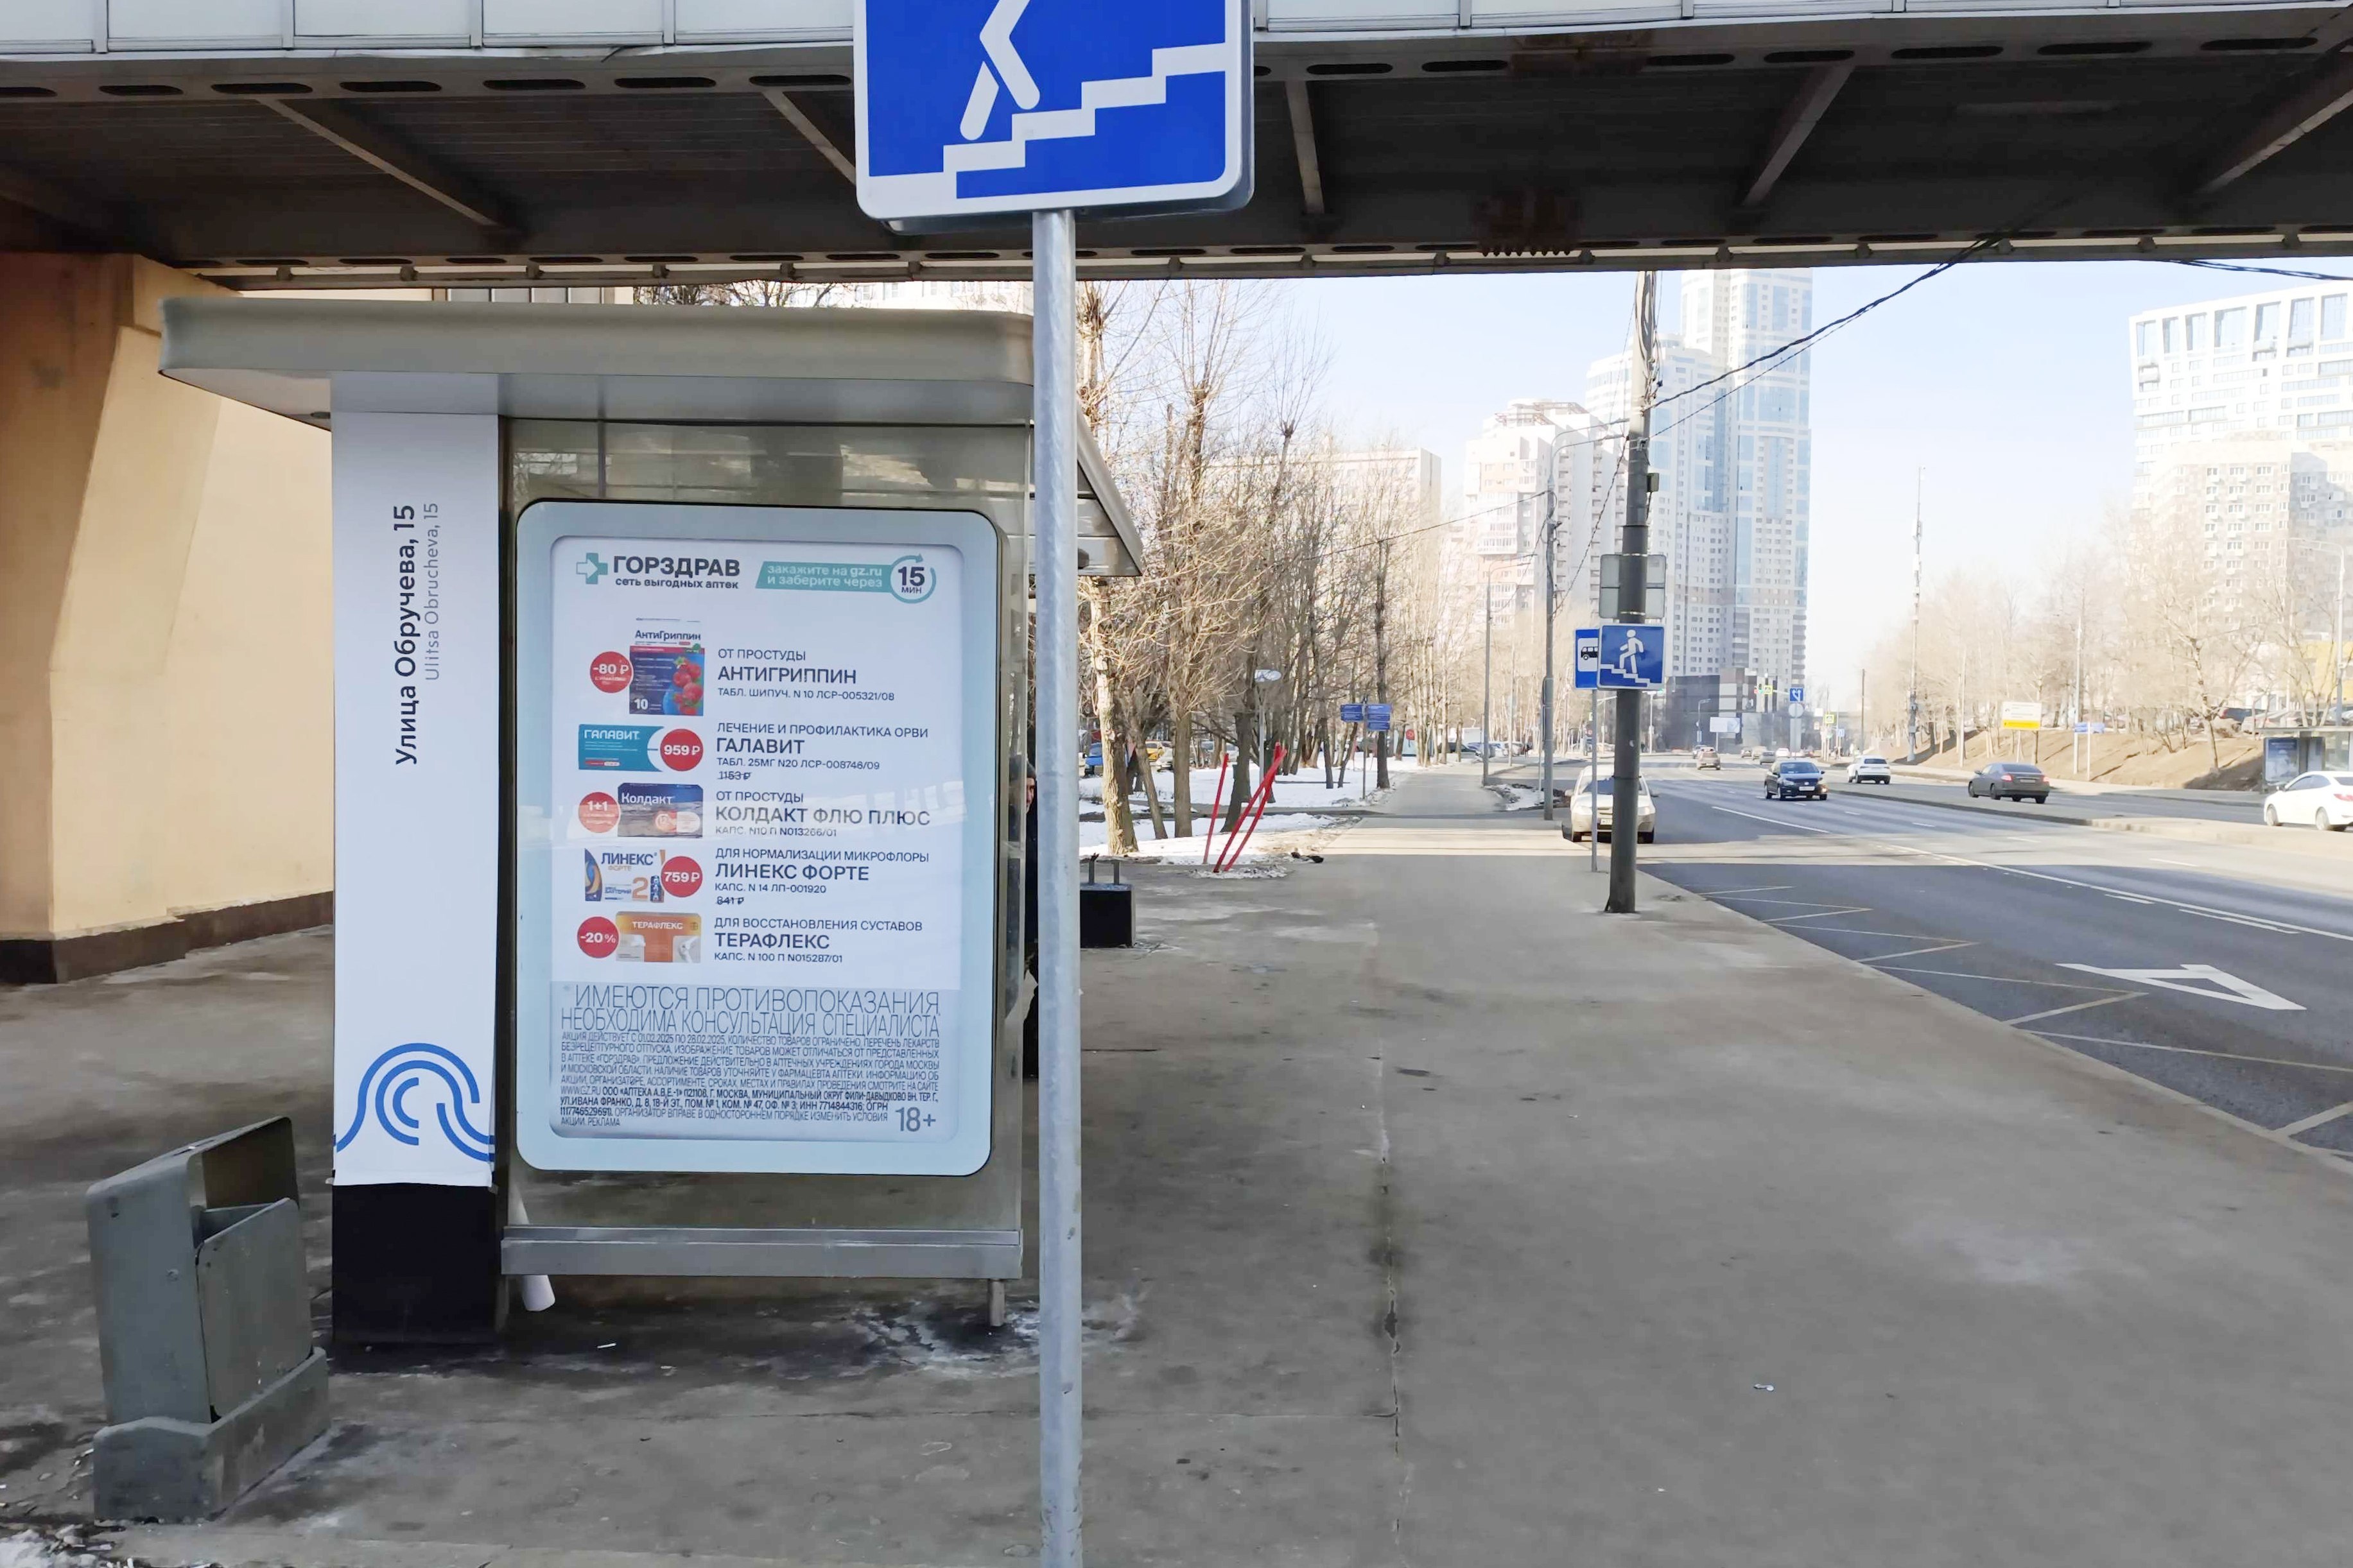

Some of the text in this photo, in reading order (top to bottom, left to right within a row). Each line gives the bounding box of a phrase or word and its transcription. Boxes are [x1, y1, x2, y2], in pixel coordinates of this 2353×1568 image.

[614, 556, 740, 578] ГОРЗДРАВ
[767, 565, 882, 578] закажите на gz.ru
[615, 578, 738, 589] сеть выгодных аптек
[767, 575, 882, 589] и заберите через
[898, 566, 926, 587] 15
[424, 503, 440, 681] Ulitsa Obrucheva, 15
[394, 505, 420, 764] Улица Обручева, 15
[635, 630, 701, 641] АнтиГриппин
[718, 648, 806, 662] ОТ ПРОСТУДЫ
[593, 664, 617, 675] -80
[718, 666, 856, 684] АНТИГРИППИН
[718, 688, 894, 701] ТАБЛ. ШИПУЧ. N 10 ЛСР-005321/08
[634, 698, 648, 710] 10
[717, 723, 928, 737] ЛЕЧЕНИЕ И ПРОФИЛАКТИКА ОРВИ
[664, 745, 690, 755] 959
[716, 737, 805, 754] ГАЛАВИТ
[717, 757, 746, 766] ТАБЛ.
[748, 758, 776, 767] 25МГ
[778, 759, 798, 768] N20
[621, 792, 674, 806] Колдакт
[716, 791, 803, 804] ОТ ПРОСТУДЫ
[587, 801, 608, 812] 1+1
[716, 806, 930, 826] КОЛДАКТ ФЛЮ ПЛЮС
[715, 826, 745, 835] КАПС.
[749, 827, 767, 836] N10
[770, 827, 777, 836] П
[601, 853, 654, 865] ЛИНЕКС
[715, 848, 929, 863] ДЛЯ НОРМАЛИЗАЦИИ МИКРОФЛОРЫ
[664, 872, 690, 883] 759
[715, 863, 869, 881] ЛИНЕКС ФОРТЕ
[715, 883, 826, 893] КАПС. N 14 ЛП-001920
[632, 922, 684, 930] ТЕРАФЛЕКС
[714, 917, 923, 931] ДЛЯ ВОССТАНОВЛЕНИЯ СУСТАВОВ
[580, 933, 603, 943] -20
[715, 932, 829, 949] ТЕРАФЛЕКС
[714, 952, 745, 961] КАПС.
[748, 953, 755, 961] N
[758, 953, 775, 961] 100
[576, 985, 689, 1010] ИМЕЮТСЯ
[561, 1007, 940, 1037] НЕОБХОДИМА КОНСУЛЬТАЦИЯ СПЕЦИАЛИСТА
[562, 1031, 587, 1041] АКЦИЯ
[587, 1031, 630, 1042] ДЕЙСТВУЕТ
[675, 1034, 686, 1044] ПО
[728, 1035, 777, 1046] КОЛИЧЕСТВО
[778, 1036, 811, 1046] ТОВАРОВ
[864, 1038, 901, 1047] ПЕРЕЧЕНЬ
[903, 1038, 940, 1048] ЛЕКАРСТВ
[561, 1042, 939, 1058] БЕЗРЕЦЕПТУРНОГО ИЗОБРАЖЕНИЕ ТОВАРОВ МОЖЕТ ОТЛИЧАТЬСЯ ОТ ПРЕДСТАВЛЕННЫХ
[568, 1053, 595, 1063] АПТЕКЕ
[643, 1055, 699, 1065] ПРЕДЛОЖЕНИЕ
[700, 1056, 765, 1067] ДЕЙСТВИТЕЛЬНО
[773, 1058, 814, 1067] АПТЕЧНЫХ
[816, 1059, 873, 1069] УЧРЕЖДЕНИЯХ
[874, 1059, 904, 1069] ГОРОДА
[906, 1060, 939, 1070] МОСКВЫ
[690, 1067, 721, 1076] ТОВАРОВ
[724, 1067, 769, 1077] УТОЧНЯЙТЕ
[777, 1069, 831, 1079] ФАРМАЦЕВТА
[866, 1071, 926, 1080] ИНФОРМАЦИЮ
[928, 1071, 939, 1080] ОБ
[740, 1079, 769, 1088] МЕСТАХ
[777, 1080, 815, 1089] ПРАВИЛАХ
[817, 1080, 867, 1090] ПРОВЕДЕНИЯ
[867, 1081, 905, 1091] СМОТРИТЕ
[907, 1082, 916, 1091] НА
[917, 1081, 939, 1091] САЙТЕ
[602, 1086, 619, 1096] ООО
[752, 1090, 821, 1100] МУНИЦИПАЛЬНЫЙ
[823, 1090, 843, 1100] ОКРУГ
[799, 1101, 817, 1110] ИНН
[866, 1101, 888, 1111] ОГРН
[614, 1107, 666, 1117] ОРГАНИЗАТОР
[667, 1108, 696, 1118] ВПРАВЕ
[704, 1109, 772, 1119] ОДНОСТОРОННЕМ
[774, 1110, 809, 1121] ПОРЯДКЕ
[896, 1107, 936, 1132] 18+
